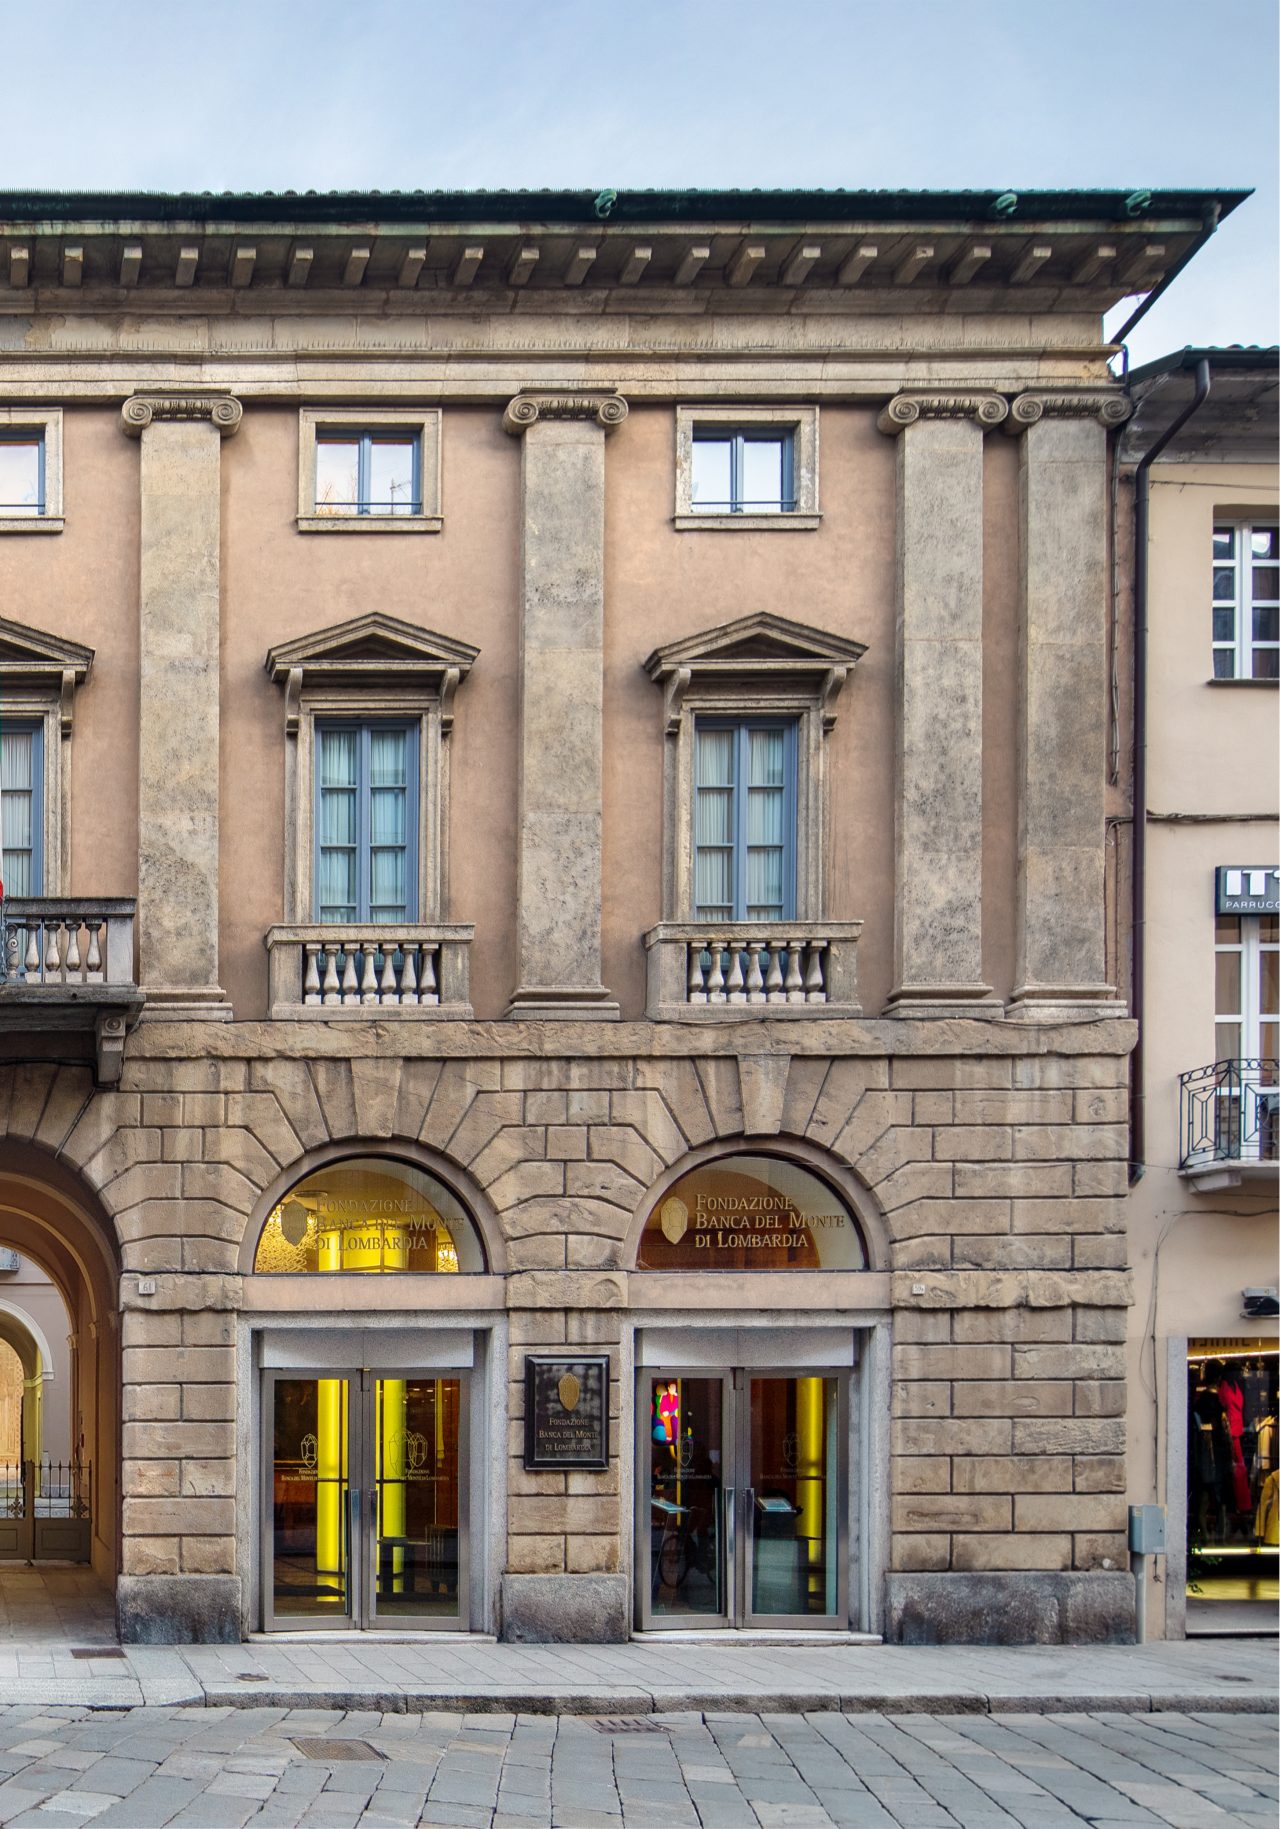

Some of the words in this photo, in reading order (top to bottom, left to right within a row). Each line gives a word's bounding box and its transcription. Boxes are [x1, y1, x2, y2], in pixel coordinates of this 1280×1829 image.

[1226, 869, 1279, 896] IT
[696, 1193, 792, 1210] FONDAZIONE
[696, 1212, 750, 1229] BANCA
[754, 1215, 782, 1229] DEL
[789, 1211, 845, 1229] MONTE
[717, 1231, 808, 1248] LOMBARDIA
